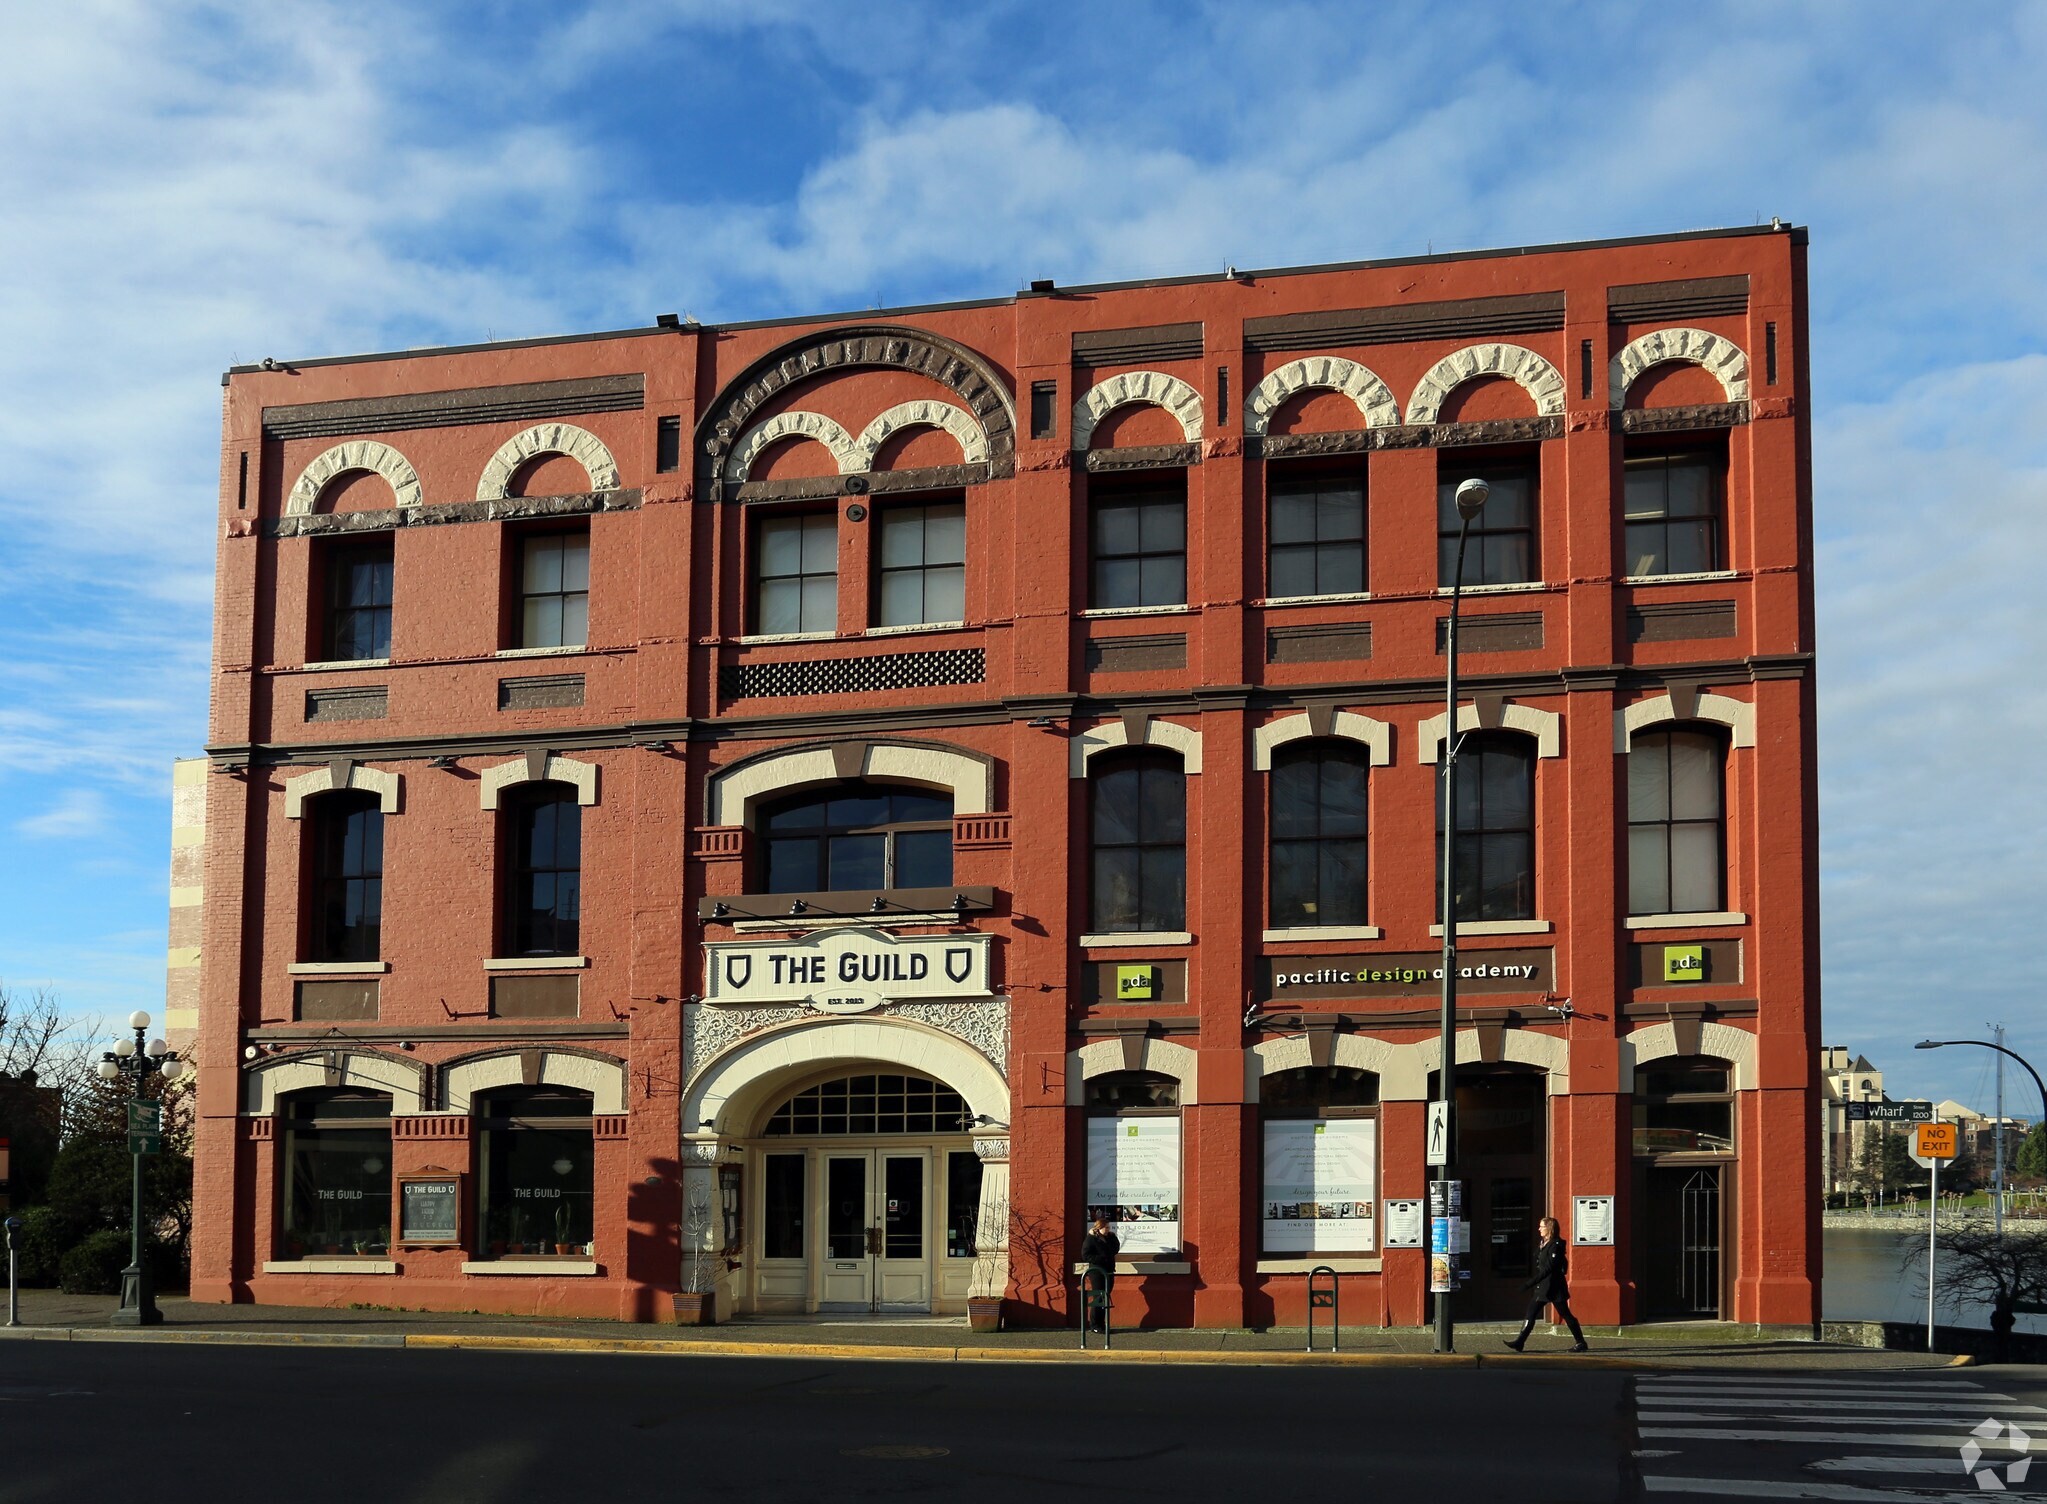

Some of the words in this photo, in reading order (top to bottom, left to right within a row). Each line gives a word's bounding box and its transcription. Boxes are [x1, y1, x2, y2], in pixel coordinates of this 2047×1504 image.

[768, 954, 826, 984] THE
[837, 952, 929, 983] GUILD
[1669, 954, 1699, 974] pda
[1276, 969, 1350, 988] pacific
[1356, 967, 1427, 983] design
[1432, 963, 1533, 979] aademy
[1120, 973, 1149, 992] pda
[1868, 1105, 1905, 1117] Wharf
[1912, 1111, 1930, 1119] 1200
[1927, 1129, 1946, 1139] NO
[1922, 1141, 1950, 1151] EXIT
[318, 1190, 335, 1199] THE
[337, 1190, 363, 1199] GUILD
[427, 1185, 447, 1194] GUILD
[513, 1188, 531, 1198] THE
[534, 1188, 561, 1198] GUILD
[1096, 1191, 1107, 1199] Are
[1119, 1190, 1129, 1198] the
[1153, 1190, 1171, 1200] type?
